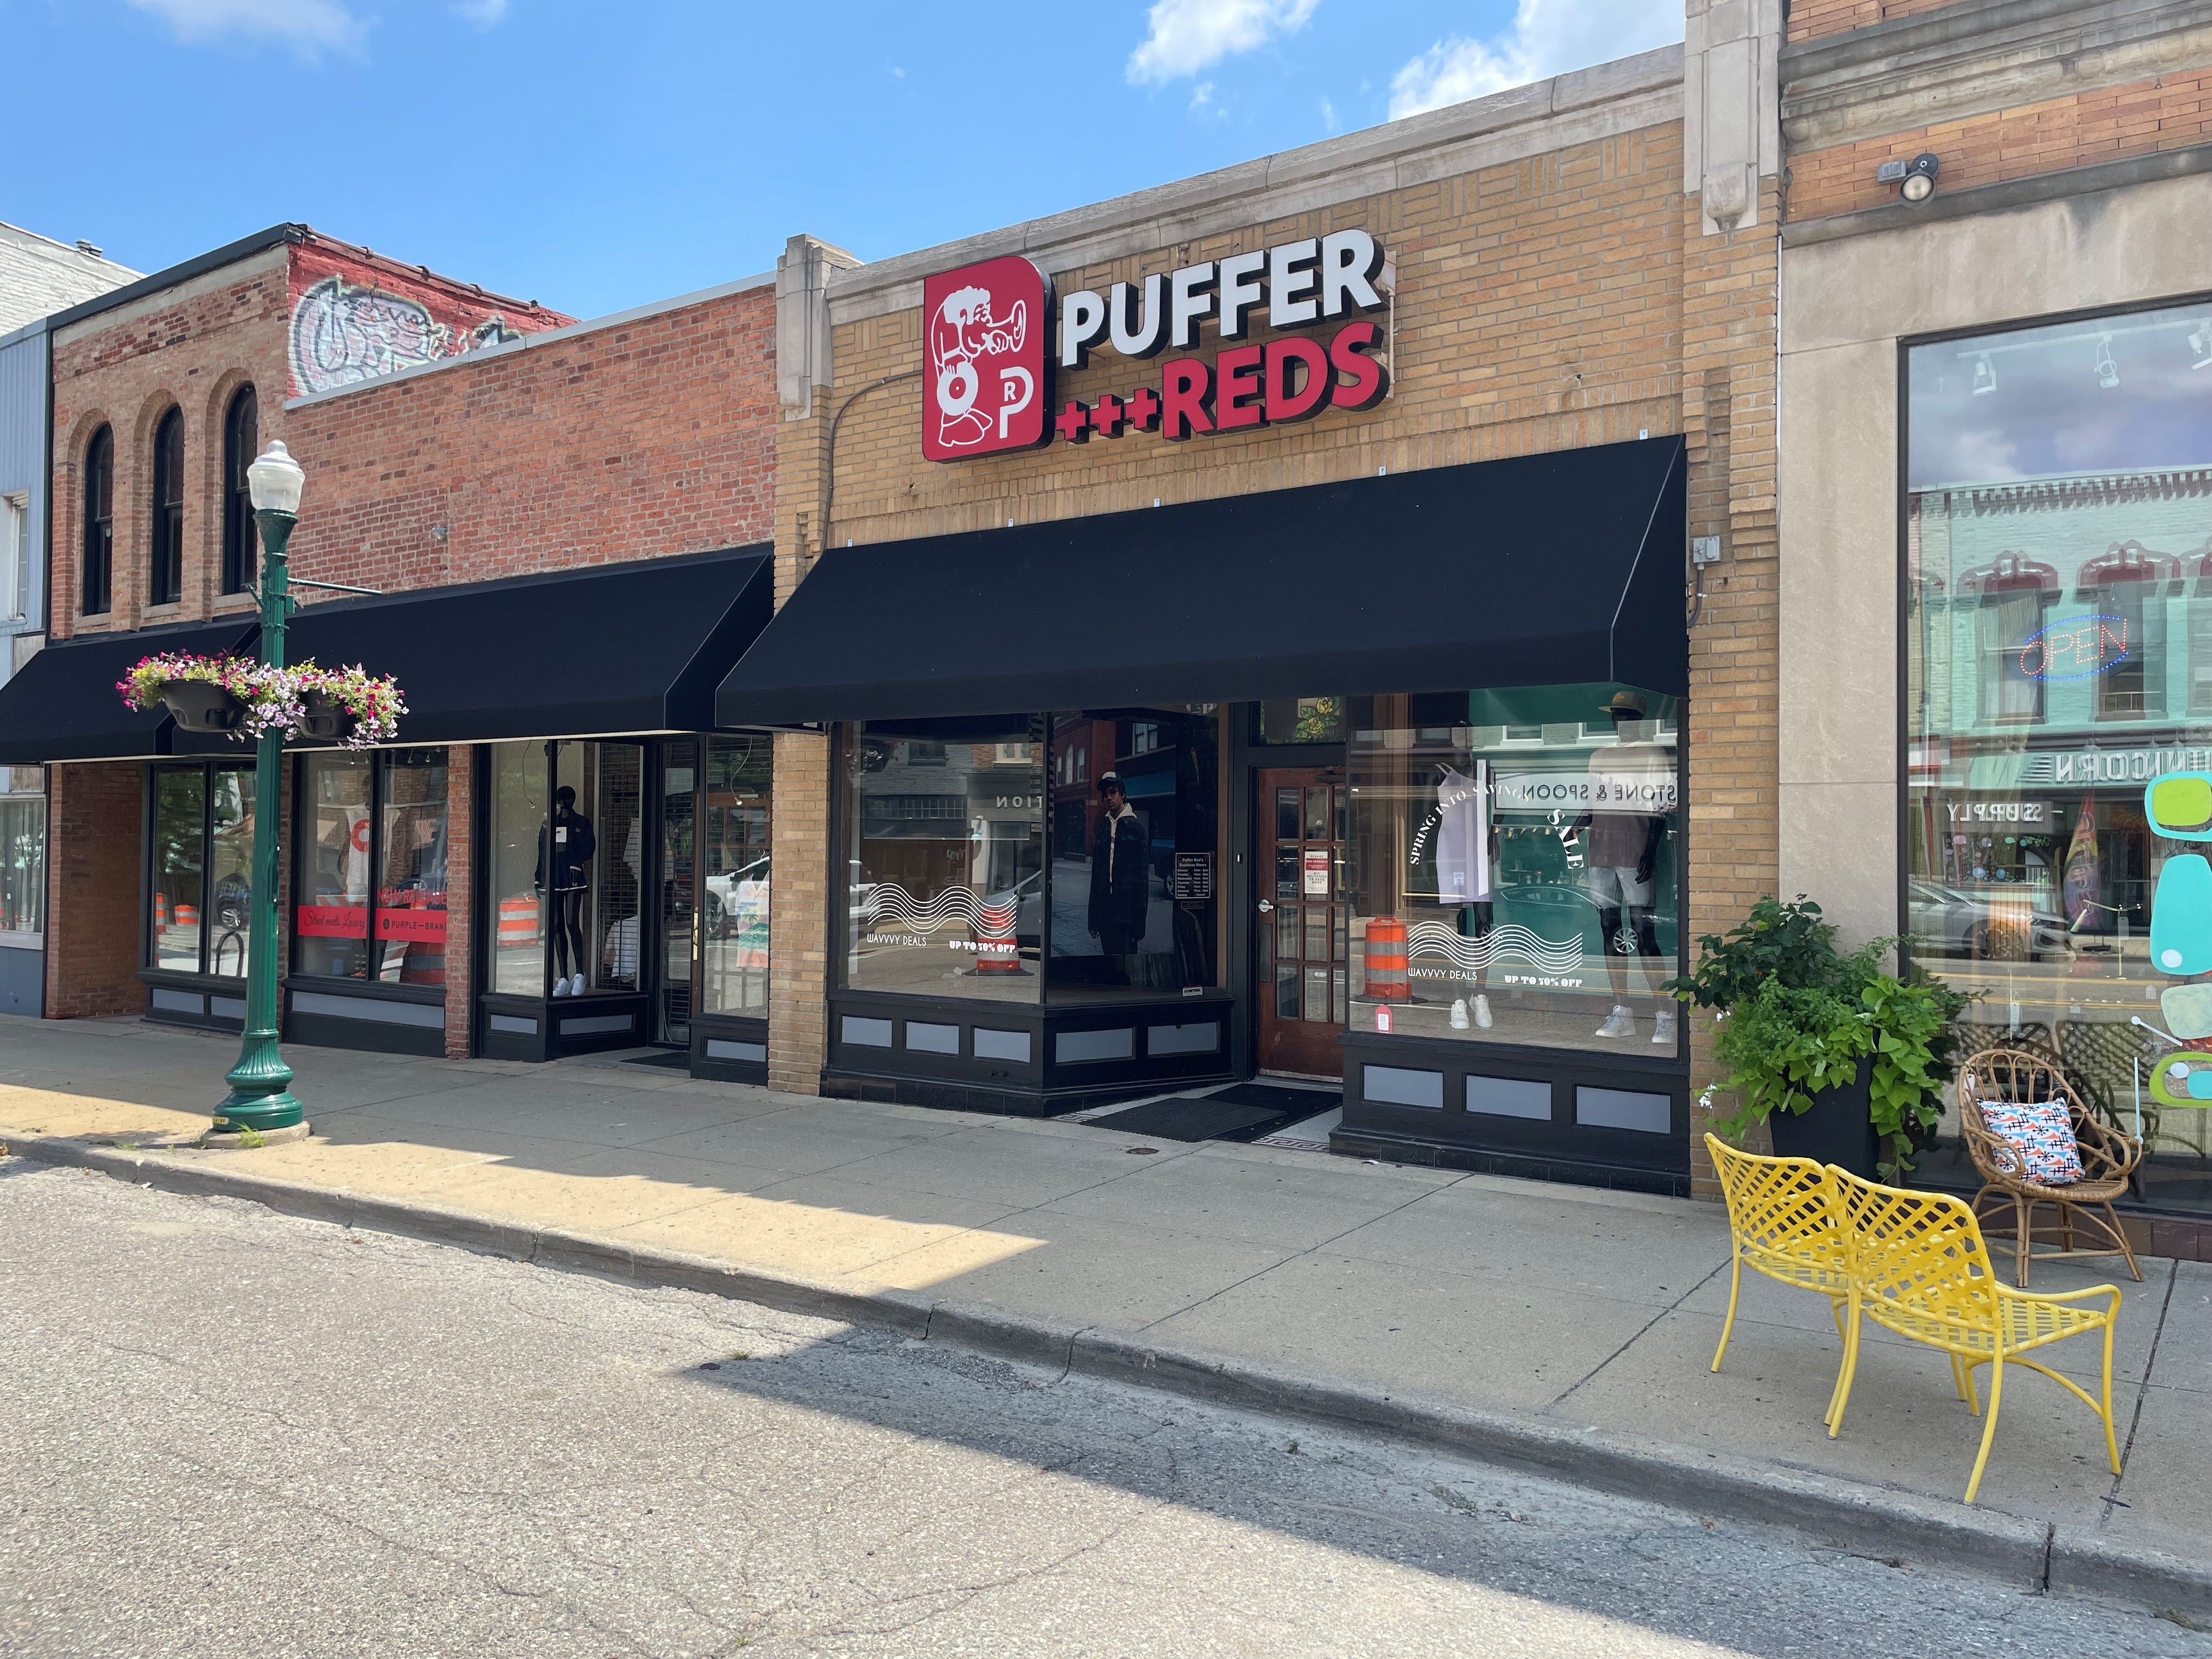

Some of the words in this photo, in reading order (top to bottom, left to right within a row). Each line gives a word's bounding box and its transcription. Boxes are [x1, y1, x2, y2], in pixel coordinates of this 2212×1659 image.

[1062, 228, 1388, 370] PUFFER
[2020, 618, 2128, 676] OPEN
[1410, 814, 1436, 866] SPRING
[1435, 791, 1467, 815] INTO
[1472, 785, 1530, 802] SAVINGS
[1547, 809, 1584, 870] SALE
[377, 887, 400, 903] NEW
[867, 933, 901, 945] WAVVVY
[902, 935, 927, 947] DEALS
[949, 940, 962, 950] UP
[963, 941, 977, 951] TO
[996, 943, 1015, 953] OFF
[1408, 967, 1447, 979] WAVVVY
[1449, 970, 1477, 981] DEALS
[1504, 974, 1519, 984] UP
[1520, 975, 1537, 985] TO
[1538, 977, 1559, 986] 70%
[1560, 978, 1583, 988] OFF
